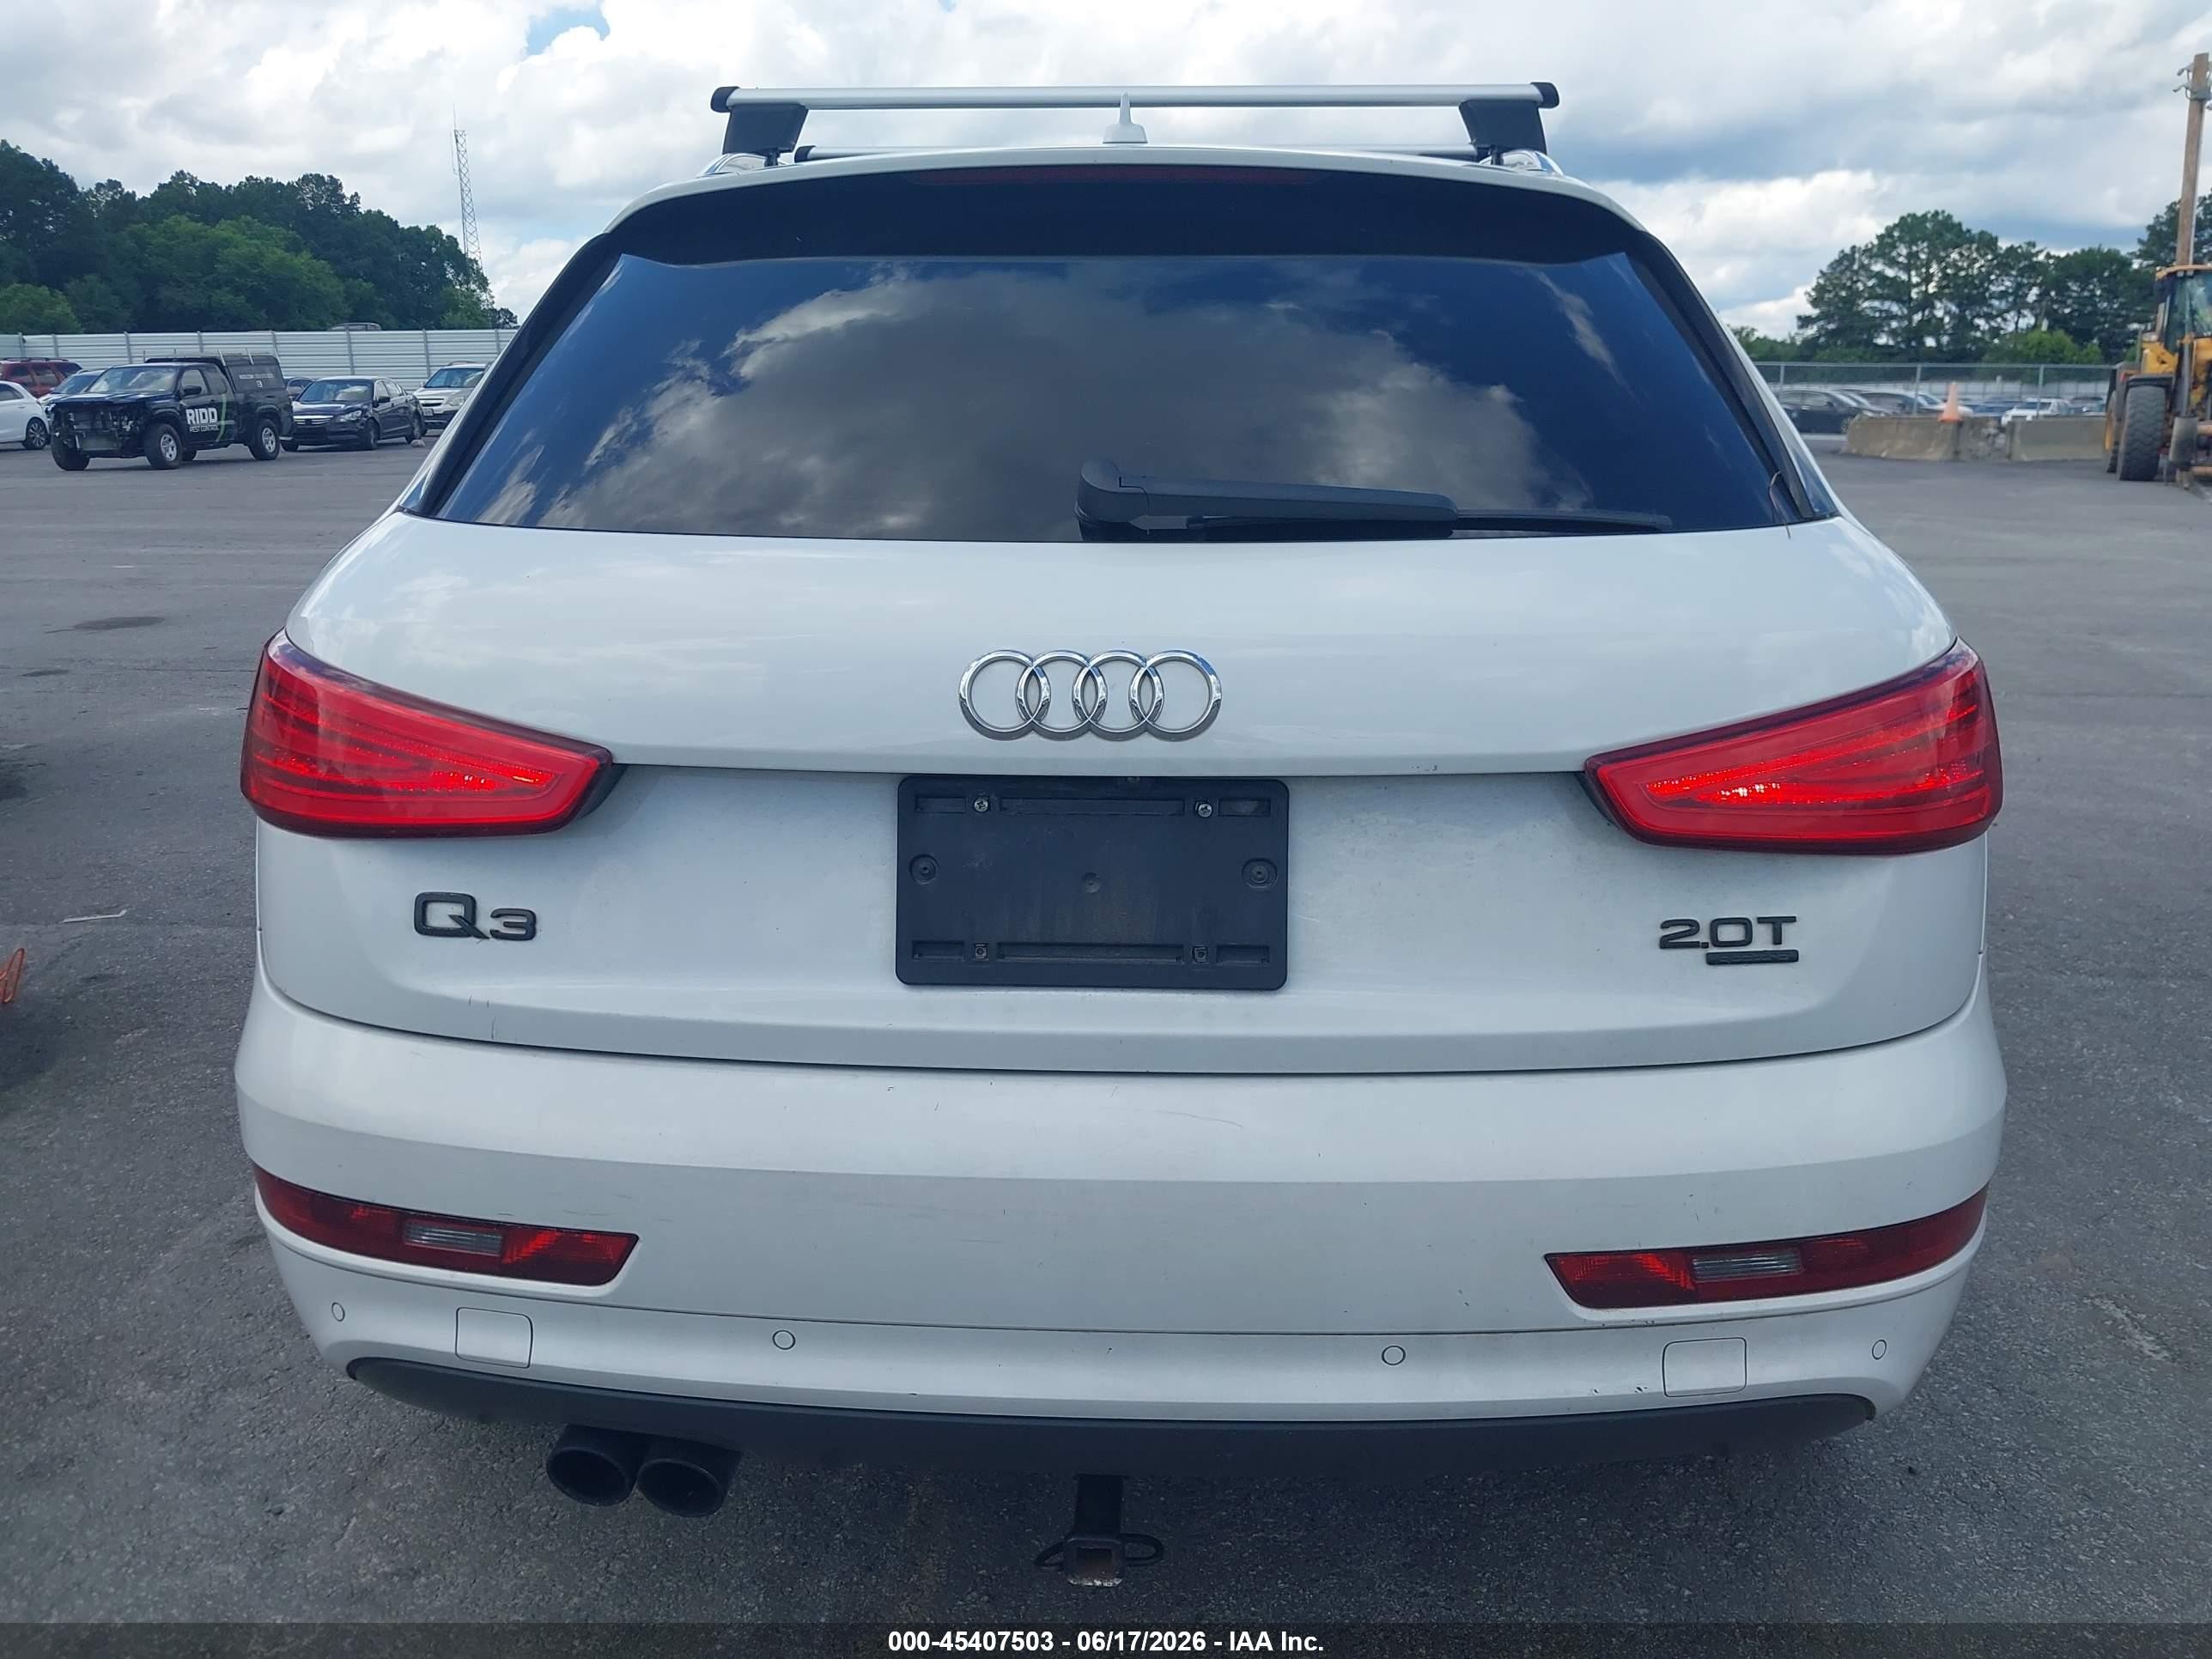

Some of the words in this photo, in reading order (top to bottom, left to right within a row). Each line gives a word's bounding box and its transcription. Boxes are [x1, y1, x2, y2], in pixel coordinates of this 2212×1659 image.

[186, 407, 217, 424] RIDD
[414, 892, 537, 941] Q3
[1659, 915, 1796, 950] 2.0T
